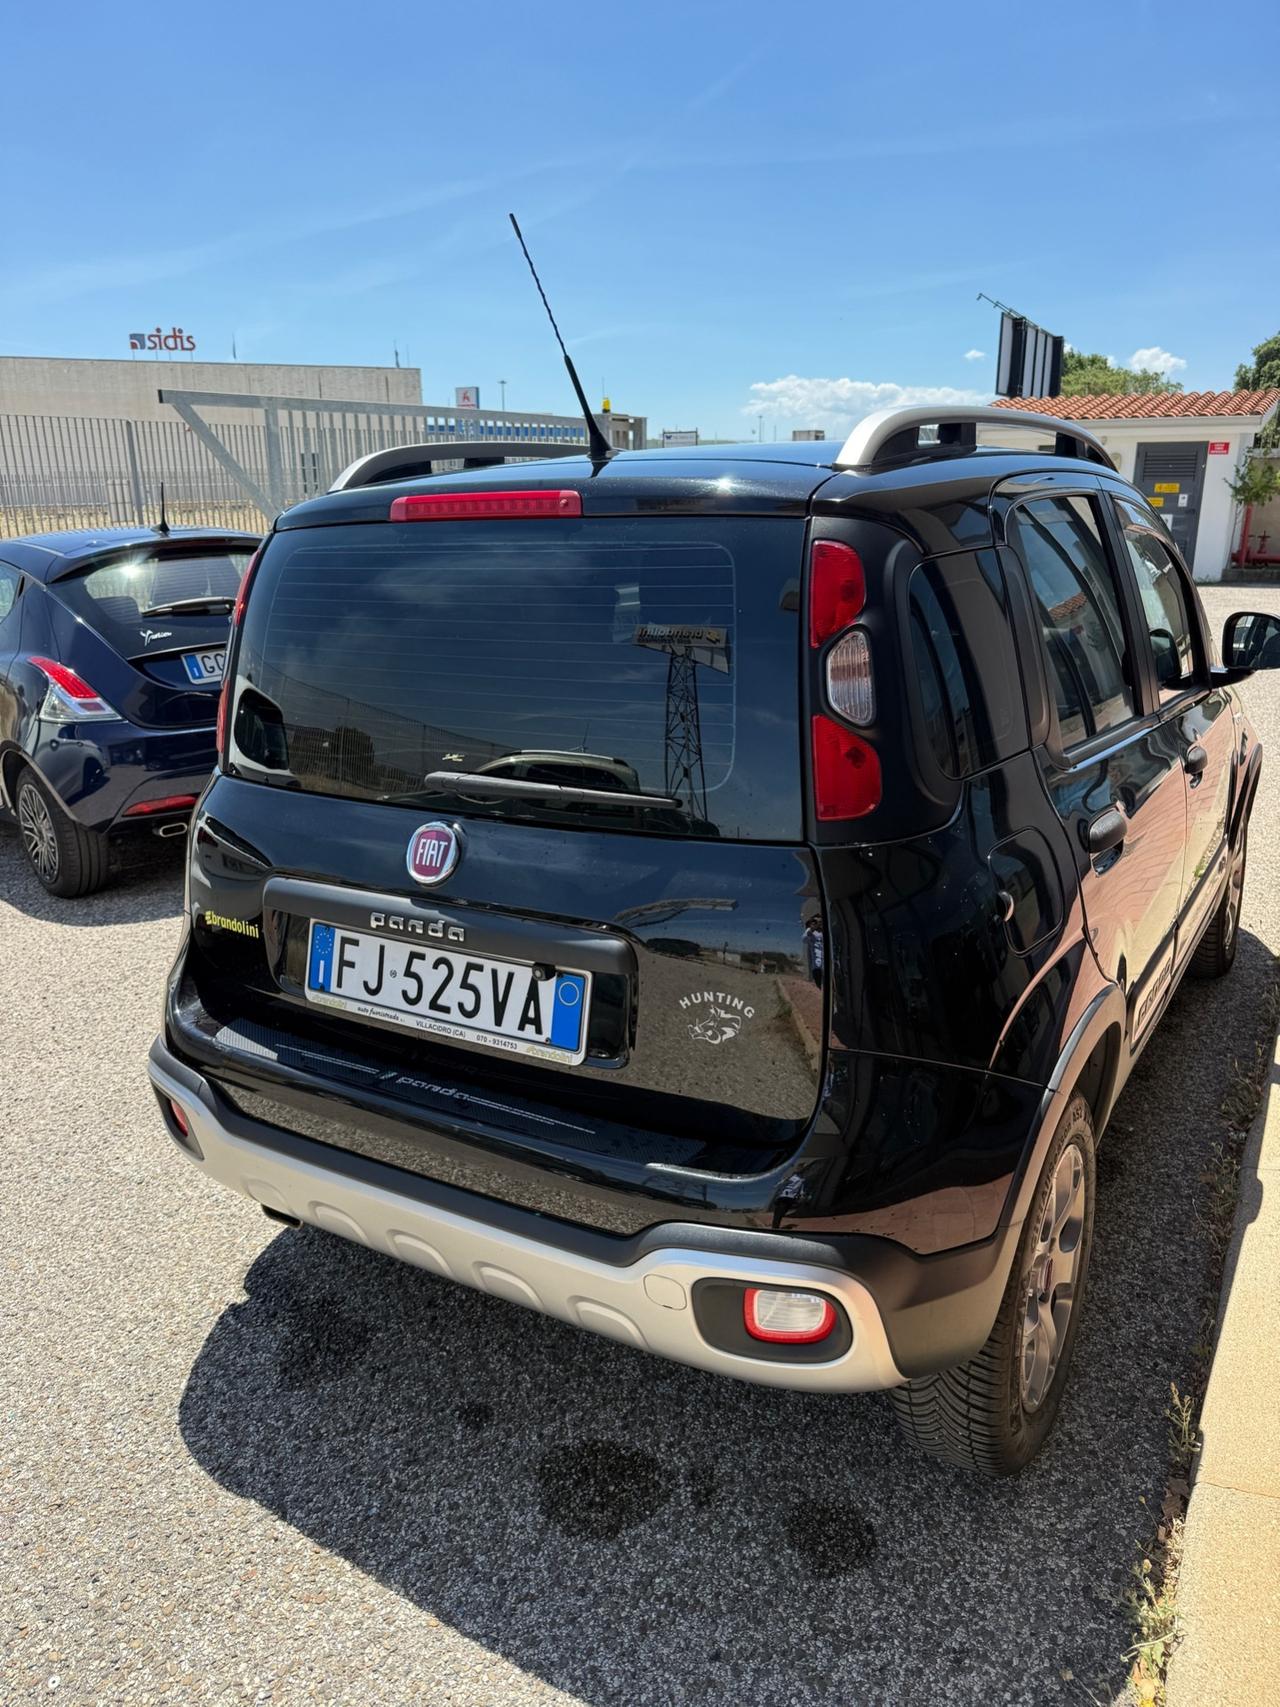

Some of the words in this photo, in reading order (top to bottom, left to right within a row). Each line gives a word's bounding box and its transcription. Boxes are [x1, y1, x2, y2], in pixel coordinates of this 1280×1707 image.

[147, 327, 196, 351] sidis
[415, 838, 448, 868] FIAT
[211, 911, 259, 939] brandolini
[370, 912, 465, 942] panda
[679, 991, 755, 1018] HUNTING
[416, 1020, 452, 1034] VILLACIDRO
[452, 1027, 466, 1038] (CA)
[476, 1034, 488, 1043] 070
[492, 1038, 518, 1050] 9314753
[396, 1076, 470, 1101] panda
